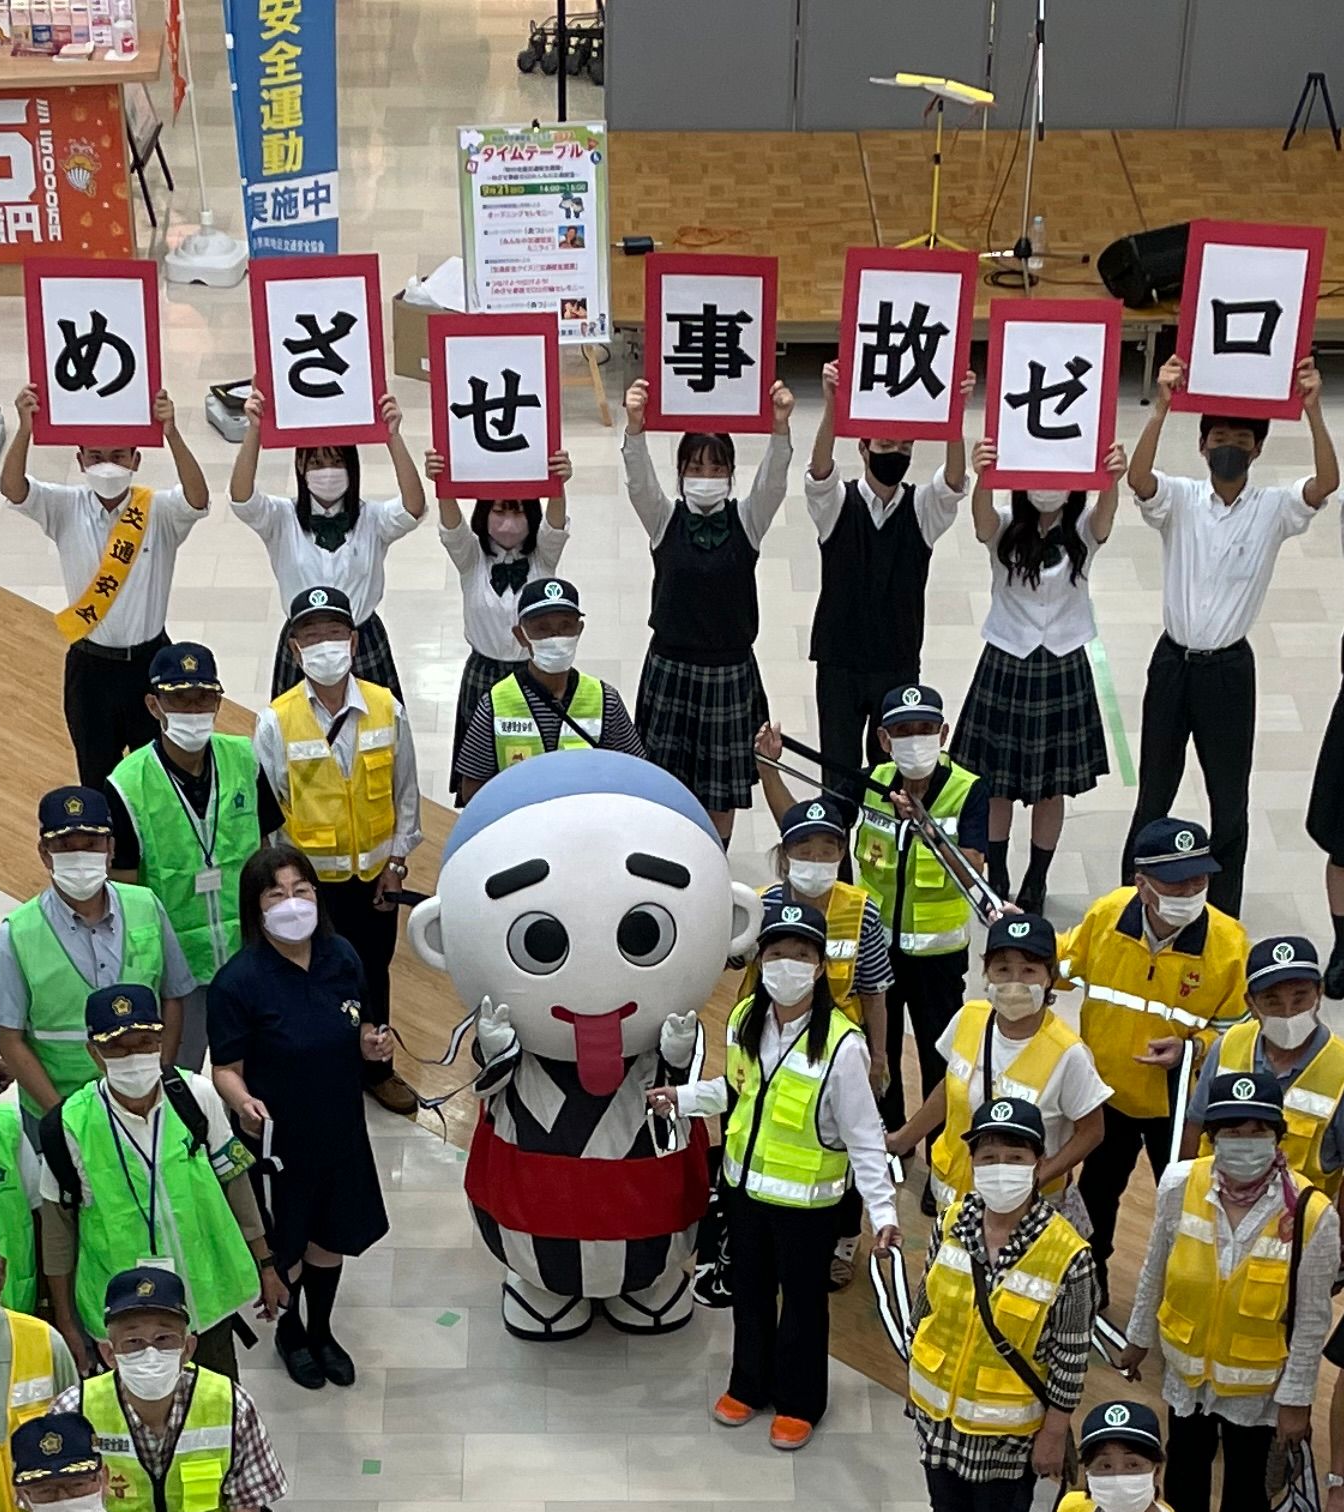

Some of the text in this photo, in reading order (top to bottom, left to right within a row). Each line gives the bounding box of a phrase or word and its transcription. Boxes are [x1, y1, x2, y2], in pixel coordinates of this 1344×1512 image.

[258, 0, 304, 176] 安全運動
[482, 143, 584, 162] タイムテーブル
[55, 311, 135, 397] め
[283, 312, 357, 398] ざ
[450, 368, 541, 452] せ
[664, 304, 755, 392] 事
[858, 301, 949, 399] 故
[1004, 357, 1092, 439] ゼ
[1212, 300, 1282, 355] ロ
[75, 506, 144, 625] 交通安全
